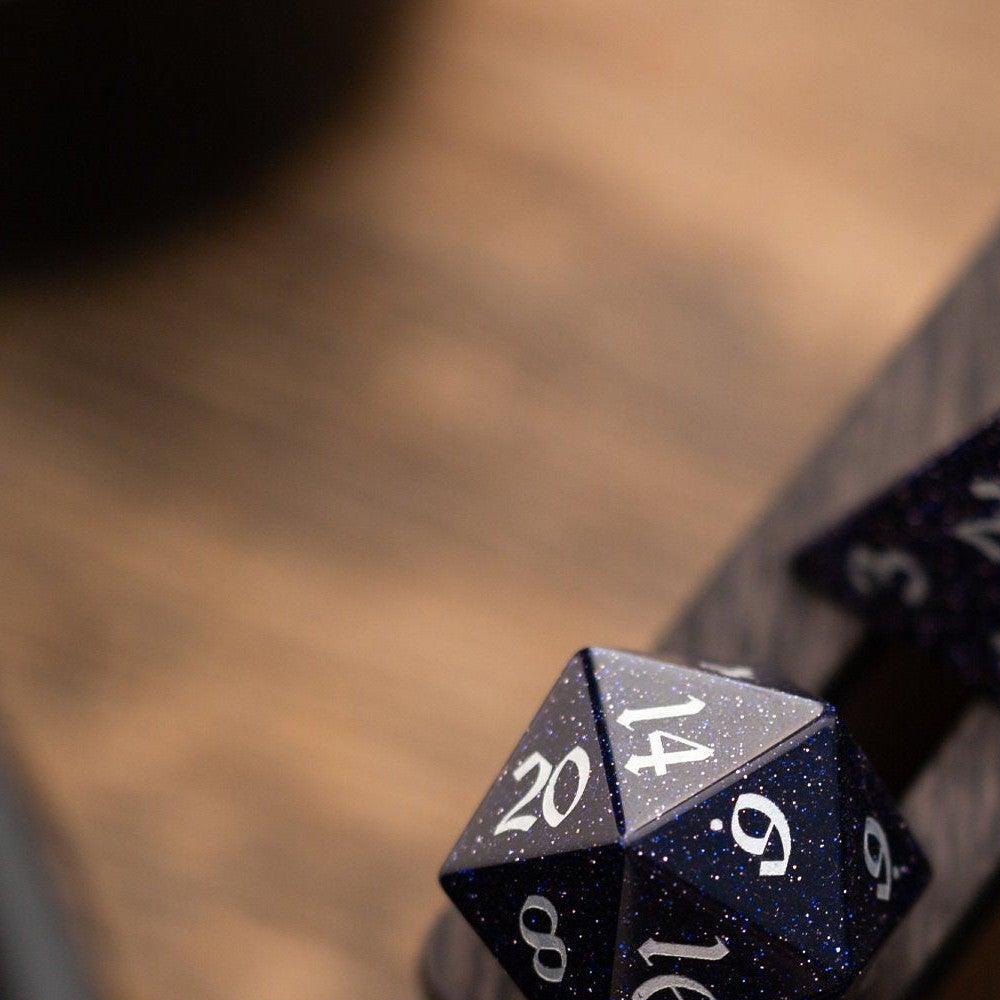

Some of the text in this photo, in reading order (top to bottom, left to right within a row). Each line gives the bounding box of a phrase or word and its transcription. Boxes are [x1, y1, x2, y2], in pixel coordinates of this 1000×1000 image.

[846, 537, 929, 606] 3
[617, 695, 714, 776] 14
[493, 745, 590, 835] 20
[519, 895, 567, 982] 8
